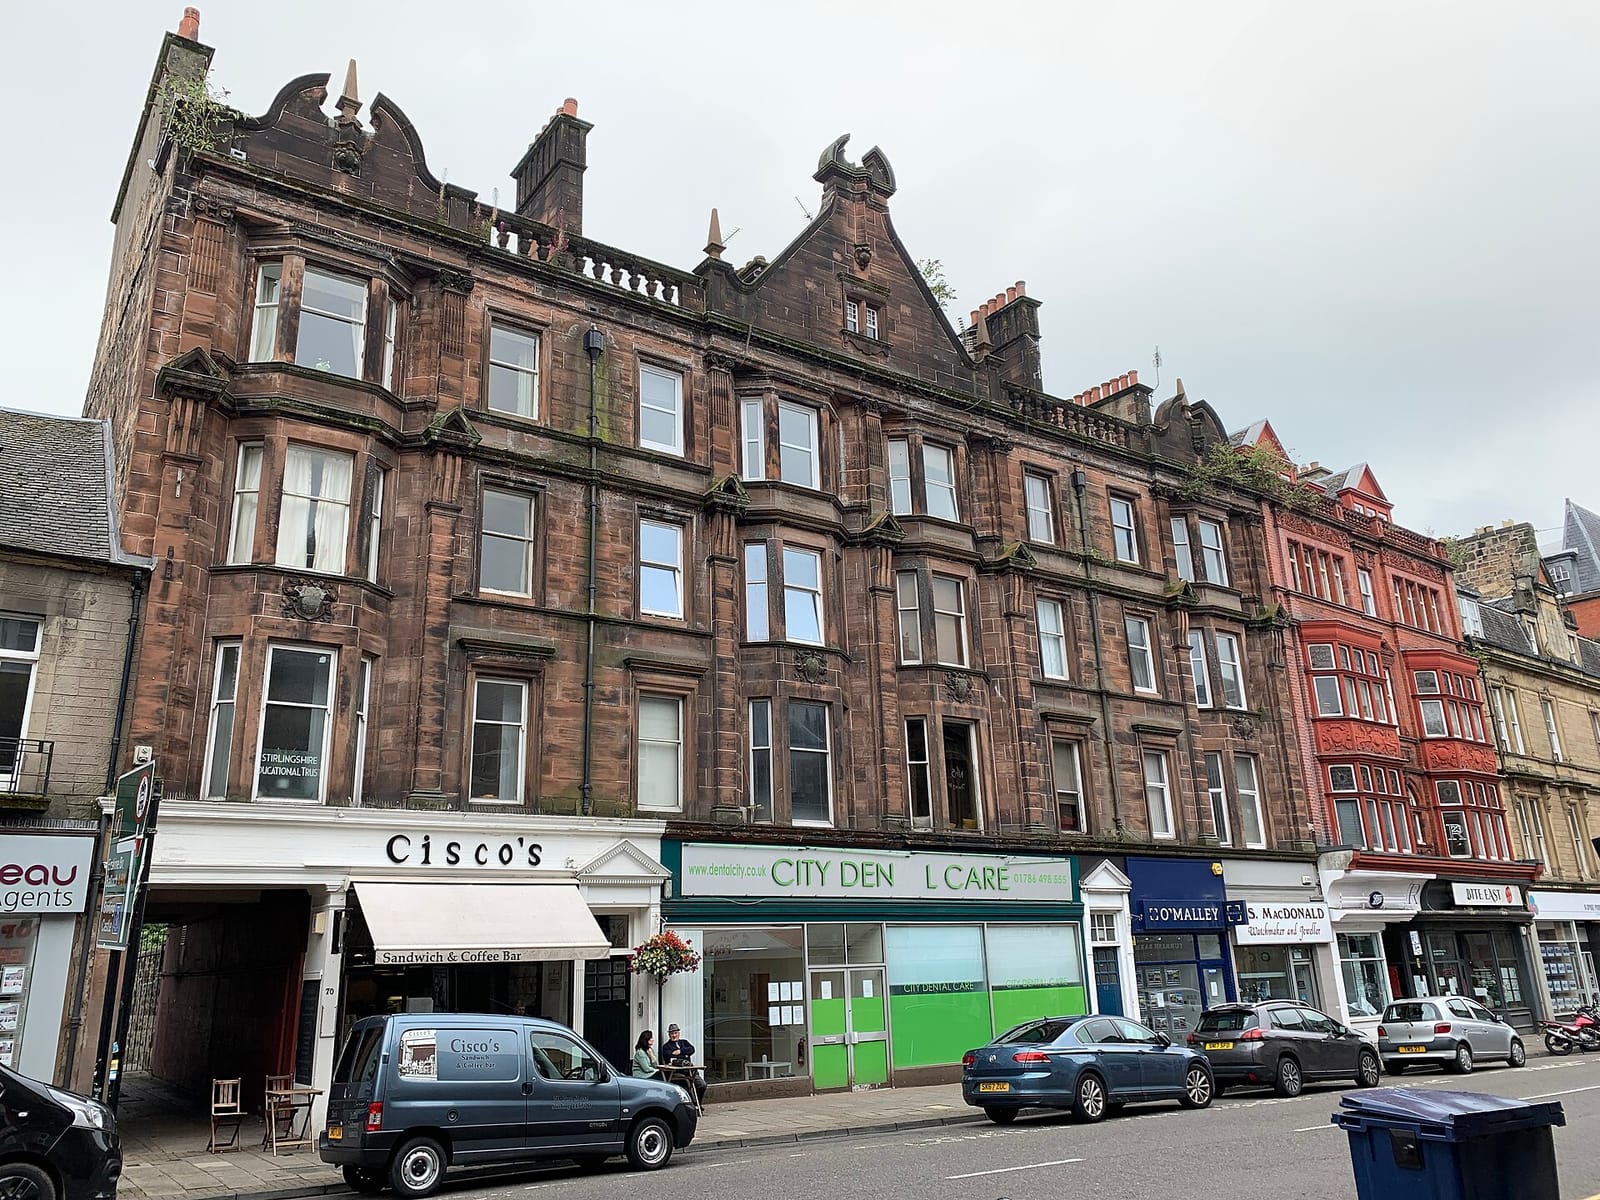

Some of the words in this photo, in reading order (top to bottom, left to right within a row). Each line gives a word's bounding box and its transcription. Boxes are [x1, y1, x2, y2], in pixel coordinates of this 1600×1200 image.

[262, 753, 318, 765] STIRLINGSHIRE
[258, 766, 301, 777] DUCATIONAL
[386, 834, 543, 866] Cisco's
[688, 862, 767, 879] www.dentalcity.co.uk
[771, 857, 832, 887] CITY
[943, 863, 1010, 891] CARE
[0, 888, 73, 912] gents
[1484, 888, 1502, 903] EAST
[1160, 907, 1218, 921] O'MALLEY
[1247, 907, 1258, 920] S.
[1247, 922, 1285, 936] Watchmaker
[1287, 922, 1298, 936] and
[382, 951, 443, 964] Sandwich
[447, 952, 458, 962] &
[461, 951, 500, 962] Coffee
[503, 951, 522, 961] Bar
[325, 987, 335, 995] 70
[903, 984, 922, 993] CITY
[922, 983, 951, 992] DENTAL
[953, 982, 974, 991] CARE
[450, 1038, 500, 1053] Cisco's
